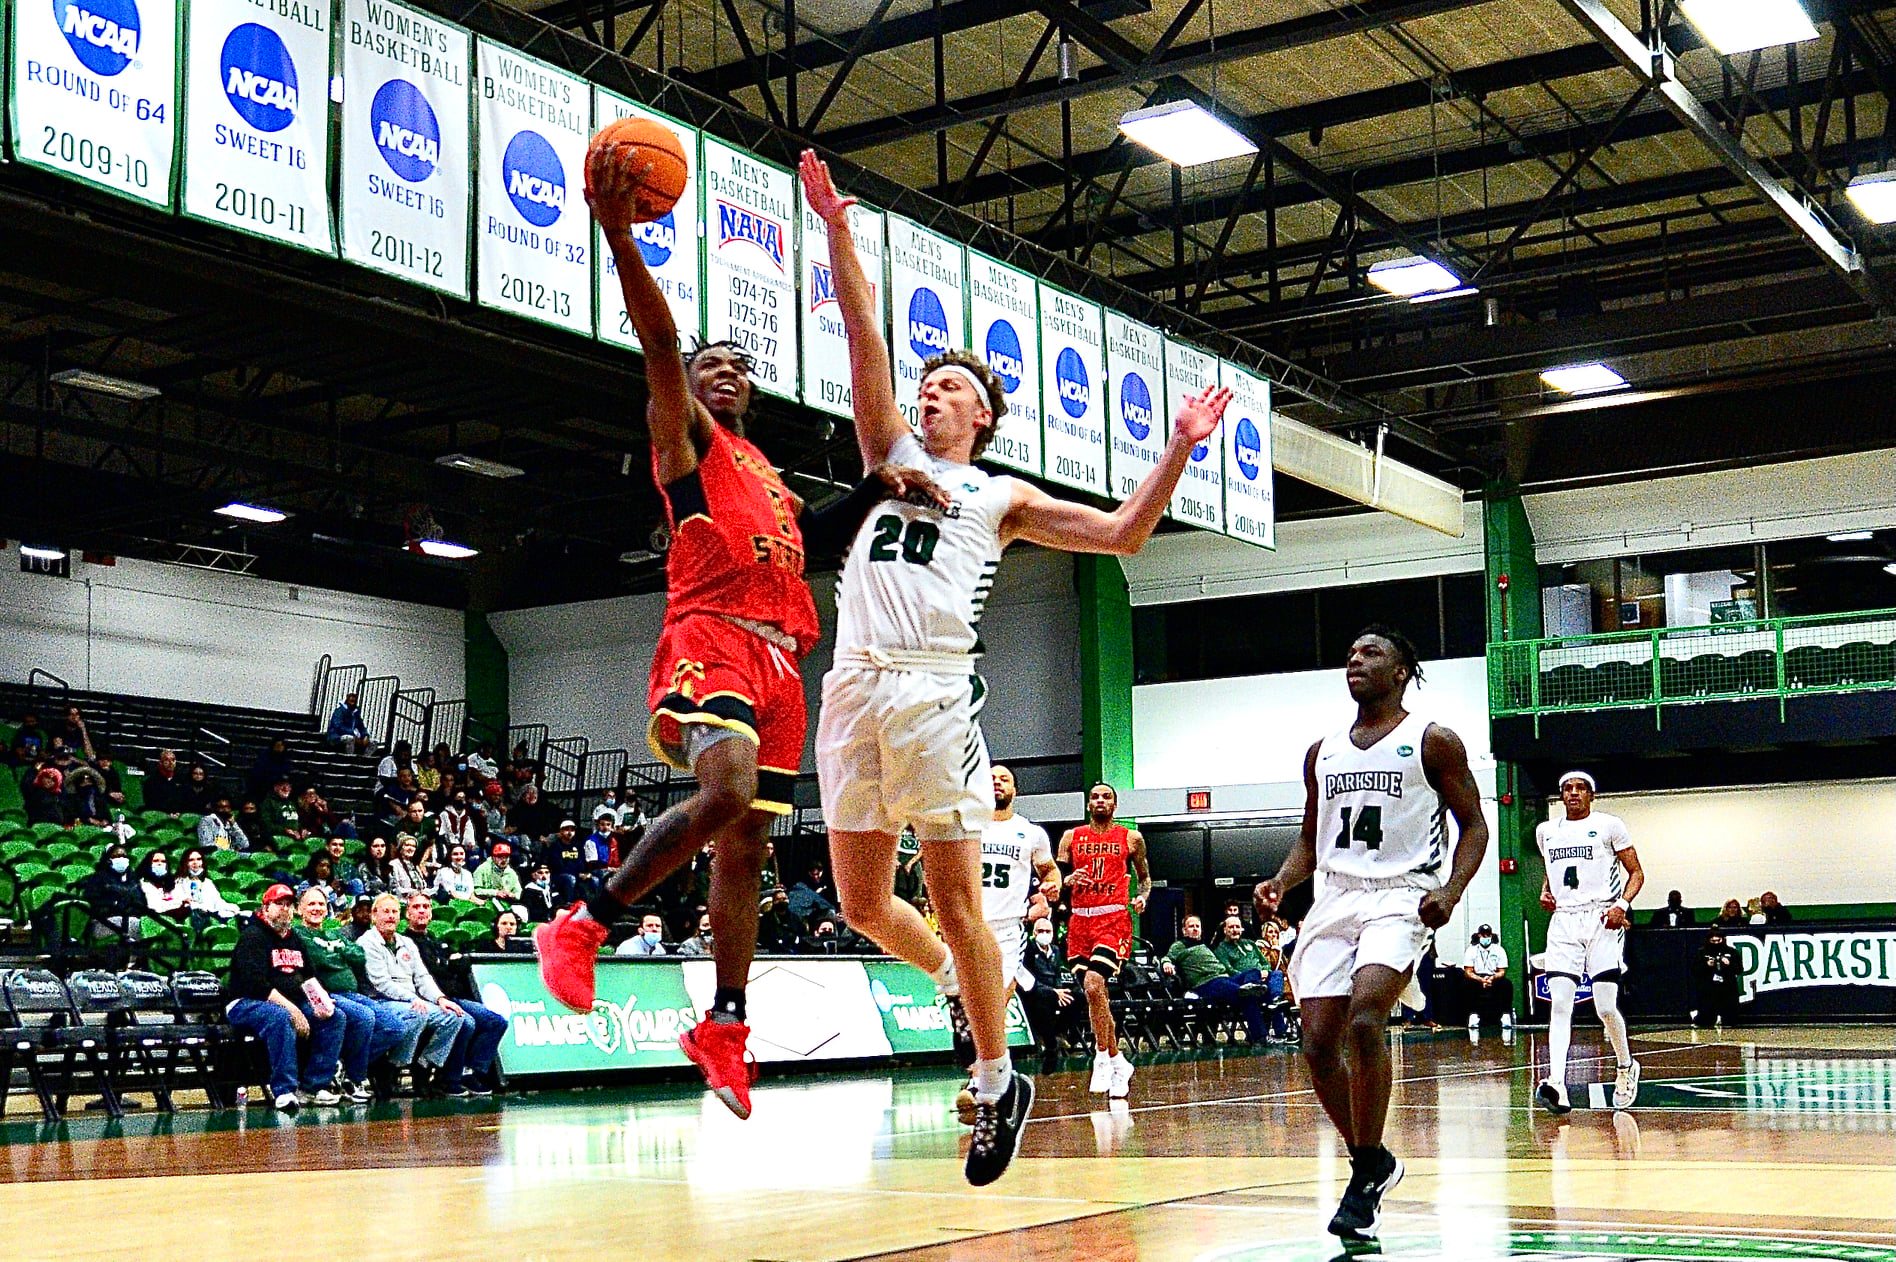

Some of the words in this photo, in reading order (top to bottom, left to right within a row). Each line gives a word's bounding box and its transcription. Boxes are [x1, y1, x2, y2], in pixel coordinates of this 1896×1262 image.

[63, 5, 138, 59] NCAA
[366, 0, 447, 53] WOMEN'S
[351, 21, 463, 86] BASKETBALL
[27, 60, 100, 102] ROUND
[109, 88, 129, 112] OF
[135, 98, 166, 124] 64
[226, 66, 298, 115] NCAA
[498, 55, 571, 104] WOMEN'S
[484, 77, 582, 135] BASKETBALL
[43, 126, 148, 188] 2009-10
[215, 124, 283, 162] SWEET
[288, 149, 306, 170] 16
[378, 120, 439, 168] NCAA
[731, 156, 769, 189] MEN'S
[215, 183, 305, 234] 2010-11
[369, 174, 425, 210] SWEET
[430, 195, 444, 218] 16
[509, 170, 565, 212] NCAA
[710, 170, 790, 220] BASKETBALL
[488, 216, 539, 250] ROUND
[545, 238, 561, 257] OF
[565, 244, 585, 265] 32
[718, 203, 782, 266] NAIA
[911, 231, 942, 261] MEN'S
[371, 231, 443, 278] 2011-12
[895, 245, 959, 289] BASKETBALL
[501, 273, 570, 317] 2012-13
[678, 282, 693, 302] 64
[728, 274, 777, 309] 1974-75
[988, 266, 1017, 293] MEN'S
[729, 298, 777, 333] 1975-76
[974, 280, 1034, 320] BASKETBALL
[1055, 296, 1084, 322] MEN'S
[729, 324, 777, 357] 1976-77
[910, 319, 949, 350] NCAA
[1043, 310, 1098, 347] BASKETBALL
[1123, 323, 1147, 347] MEN'S
[990, 350, 1024, 379] NCAA
[1109, 337, 1159, 372] BASKETBALL
[820, 378, 852, 408] 1974
[1059, 377, 1090, 405] NCAA
[1011, 402, 1021, 417] OF
[1026, 407, 1036, 422] 64
[1048, 414, 1076, 437] ROUND
[1079, 425, 1088, 441] OF
[1090, 430, 1102, 445] 64
[1124, 399, 1152, 427] NCAA
[1114, 437, 1140, 458] ROUND
[1141, 448, 1151, 462] OF
[1237, 443, 1261, 467] NCAA
[1056, 456, 1096, 484] 2013-14
[1200, 469, 1209, 481] OF
[1211, 471, 1219, 485] 32
[1228, 476, 1251, 497] ROUND
[1181, 496, 1215, 523] 2015-16
[1234, 513, 1266, 538] 2016-17
[869, 514, 940, 567] 20
[1326, 771, 1403, 800] PARKSIDE
[1335, 805, 1384, 850] 14
[1077, 842, 1121, 856] FERRIS
[1548, 846, 1594, 863] PARKSIDE
[1563, 866, 1579, 890] 4
[1730, 934, 1896, 1000] PARKSI
[514, 1014, 588, 1046] MAKE
